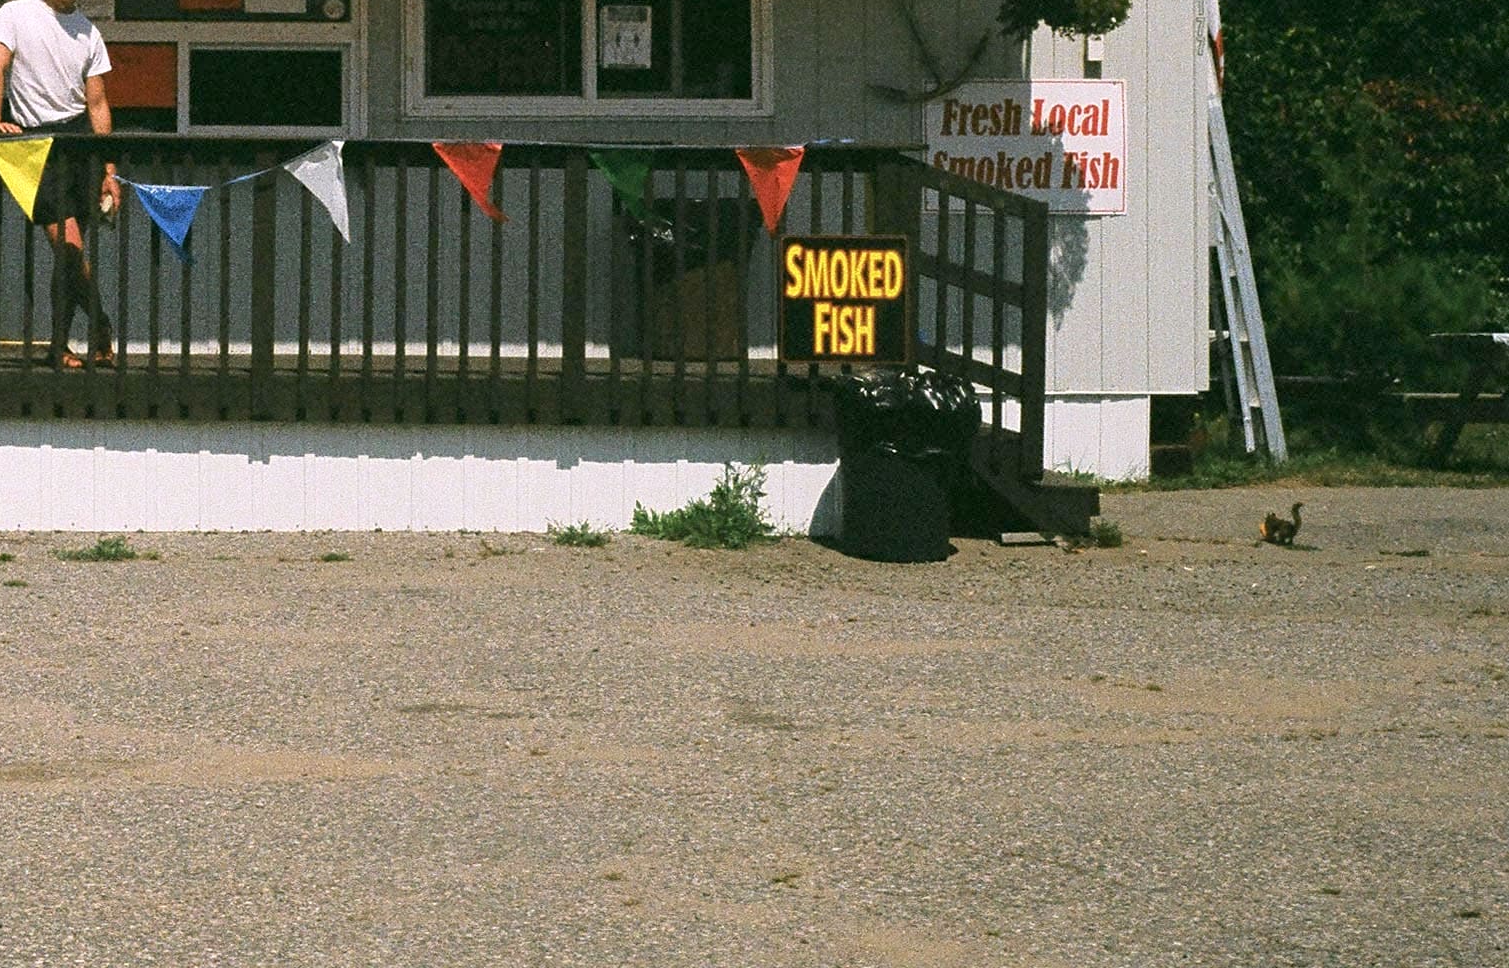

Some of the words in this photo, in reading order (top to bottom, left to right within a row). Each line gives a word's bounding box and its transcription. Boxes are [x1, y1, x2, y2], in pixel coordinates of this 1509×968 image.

[940, 98, 1023, 136] Fresh
[1030, 98, 1110, 136] Local
[1060, 150, 1120, 190] Fish
[784, 243, 905, 299] SMOKED
[812, 302, 876, 356] FISH
